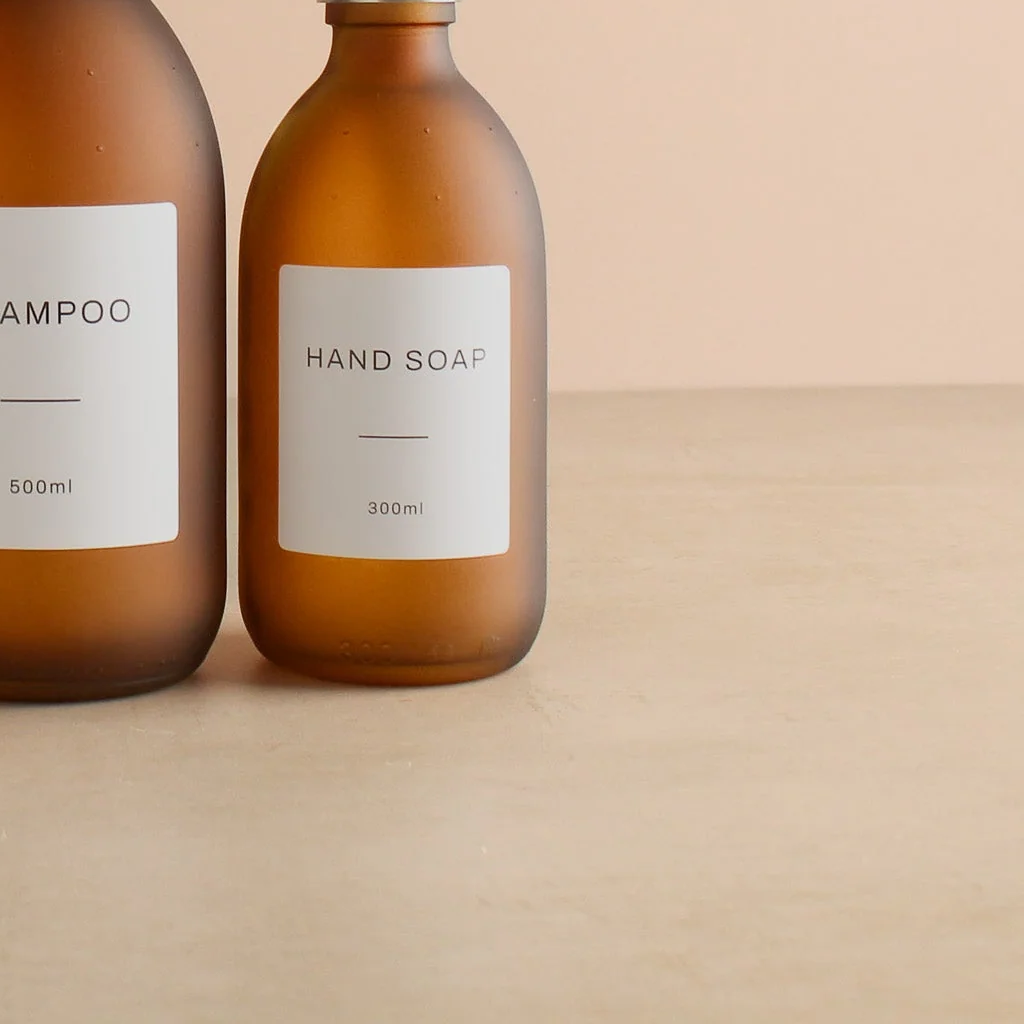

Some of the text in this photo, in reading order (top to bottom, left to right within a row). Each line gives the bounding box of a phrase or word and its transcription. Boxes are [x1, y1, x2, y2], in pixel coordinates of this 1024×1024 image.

[306, 346, 487, 371] HAND SOAP
[9, 477, 73, 495] 500ml
[367, 501, 423, 516] 300ml
